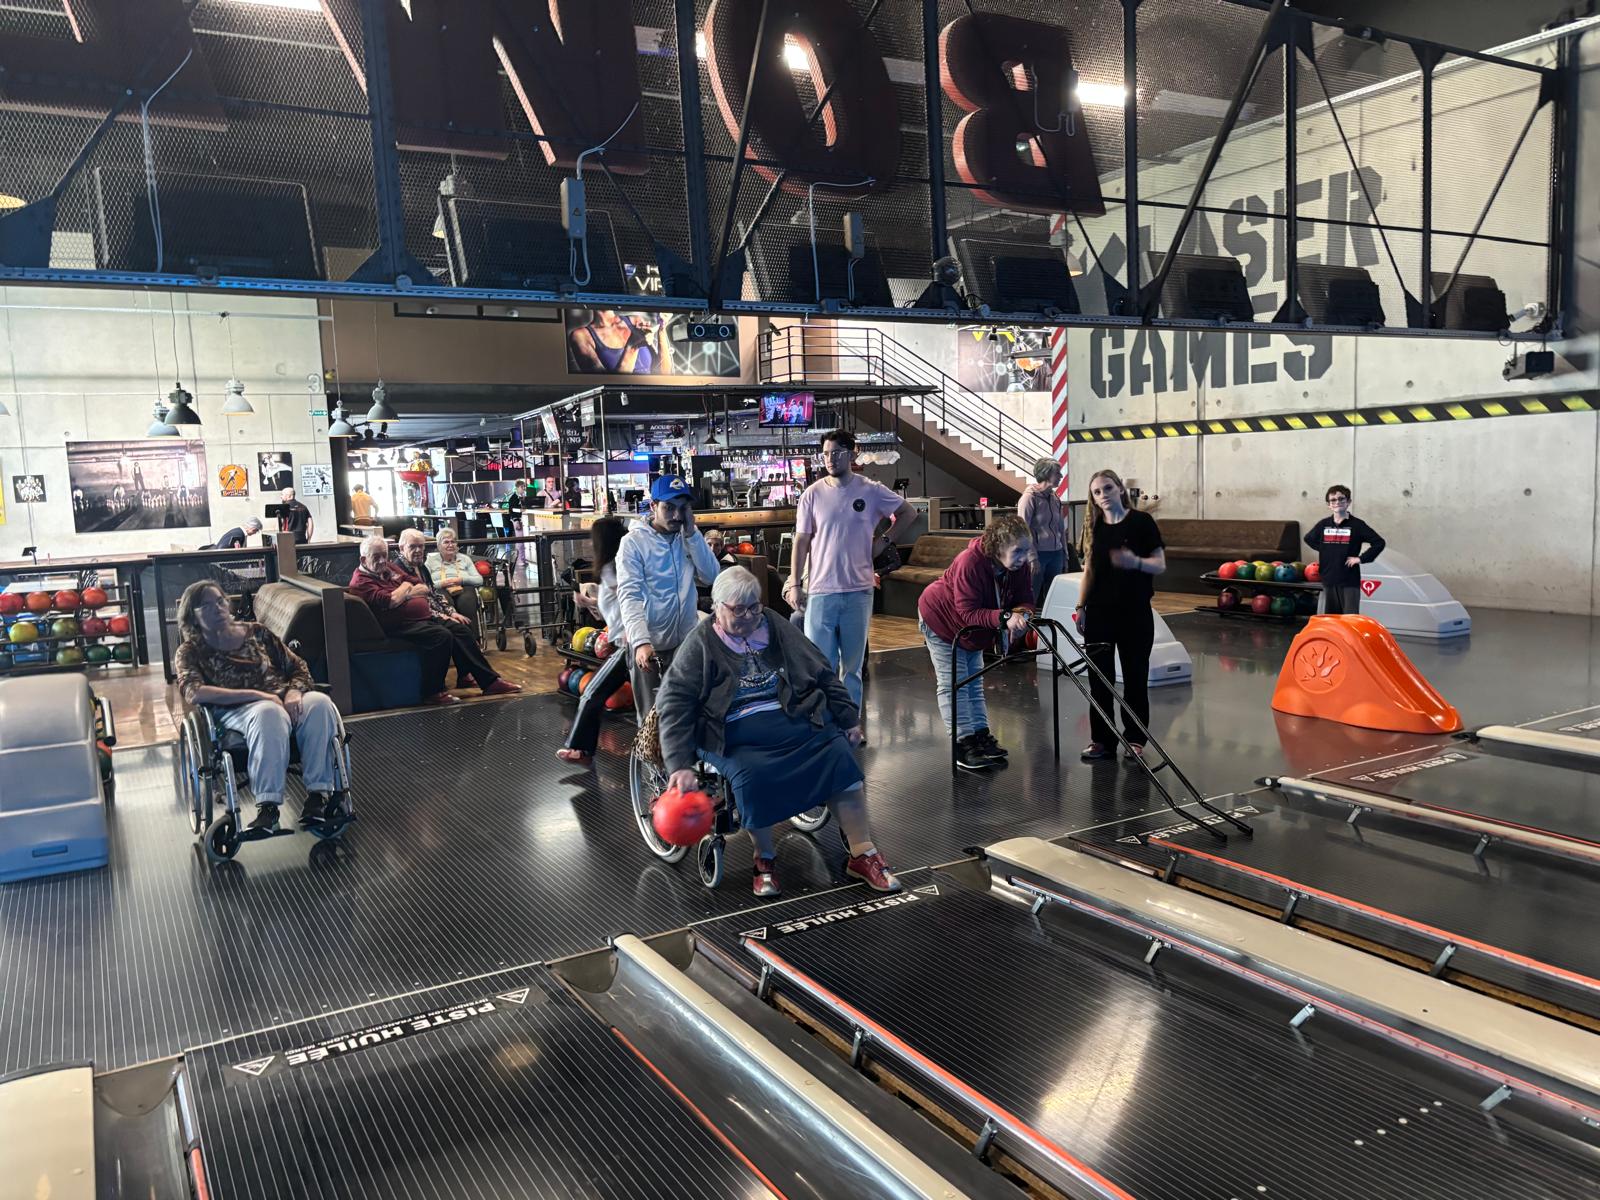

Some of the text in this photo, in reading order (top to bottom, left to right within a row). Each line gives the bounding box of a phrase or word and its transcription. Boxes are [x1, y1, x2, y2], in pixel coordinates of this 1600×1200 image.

[777, 893, 920, 934] PISTE HUILÉE
[288, 1001, 496, 1065] PISTE HUILÉE
